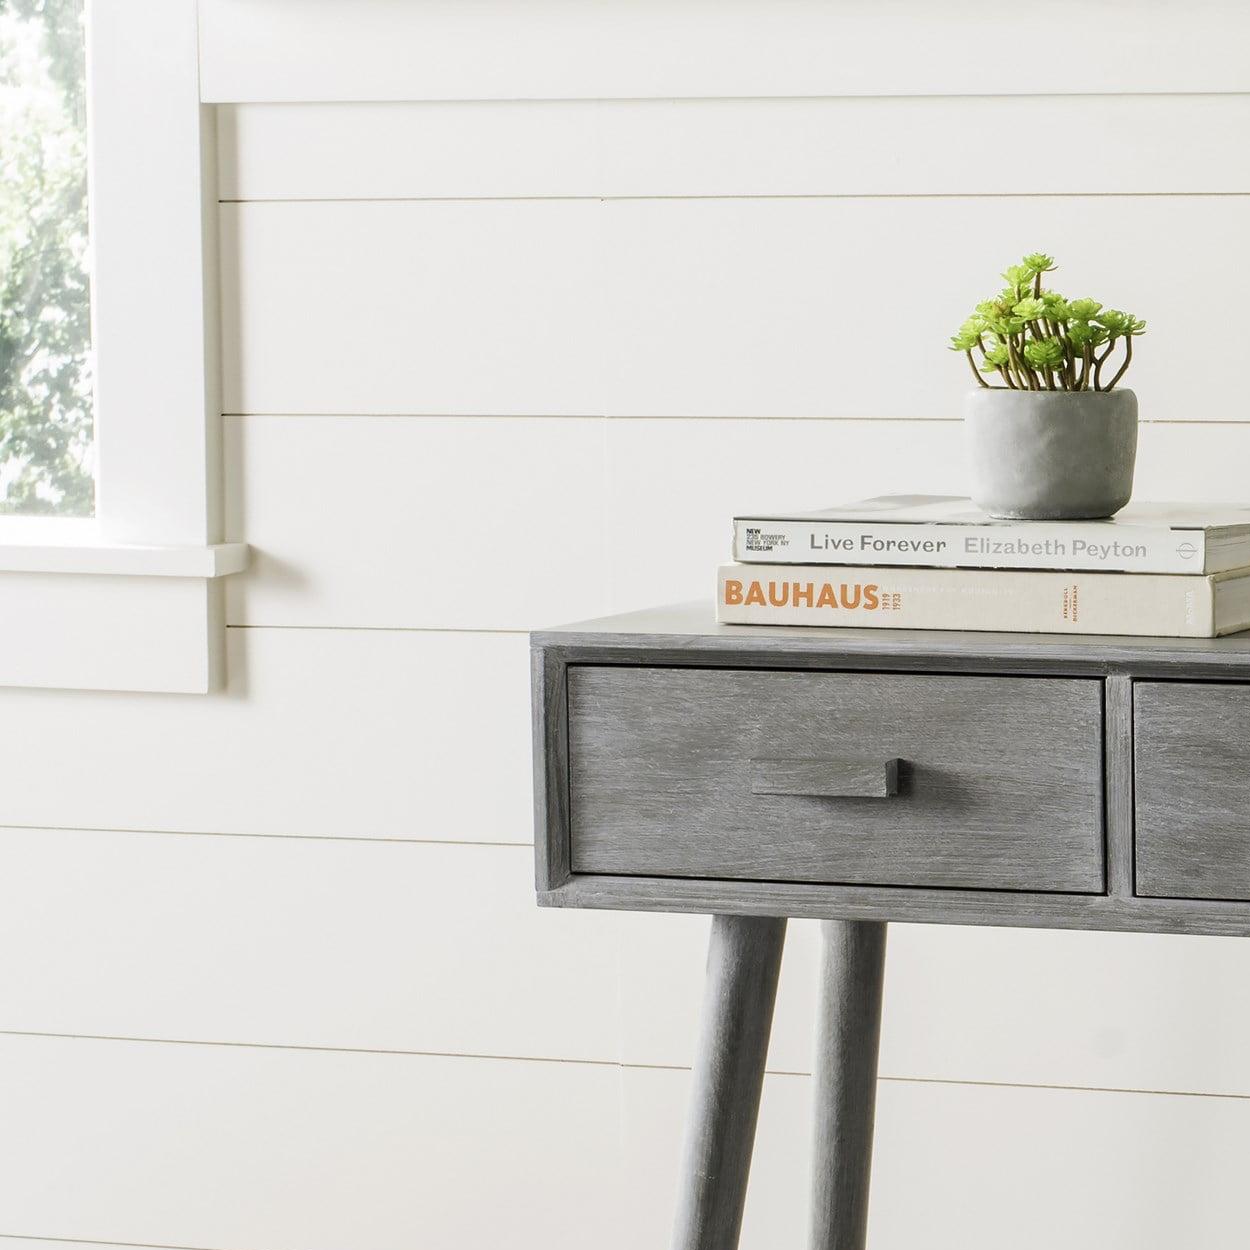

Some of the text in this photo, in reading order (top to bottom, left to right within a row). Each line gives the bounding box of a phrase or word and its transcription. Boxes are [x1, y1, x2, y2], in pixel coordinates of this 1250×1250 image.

[810, 534, 1147, 560] Live Forever Elizabeth Peyton
[725, 579, 879, 610] BAUHAUS
[882, 593, 890, 610] 1919
[892, 593, 901, 610] 1933
